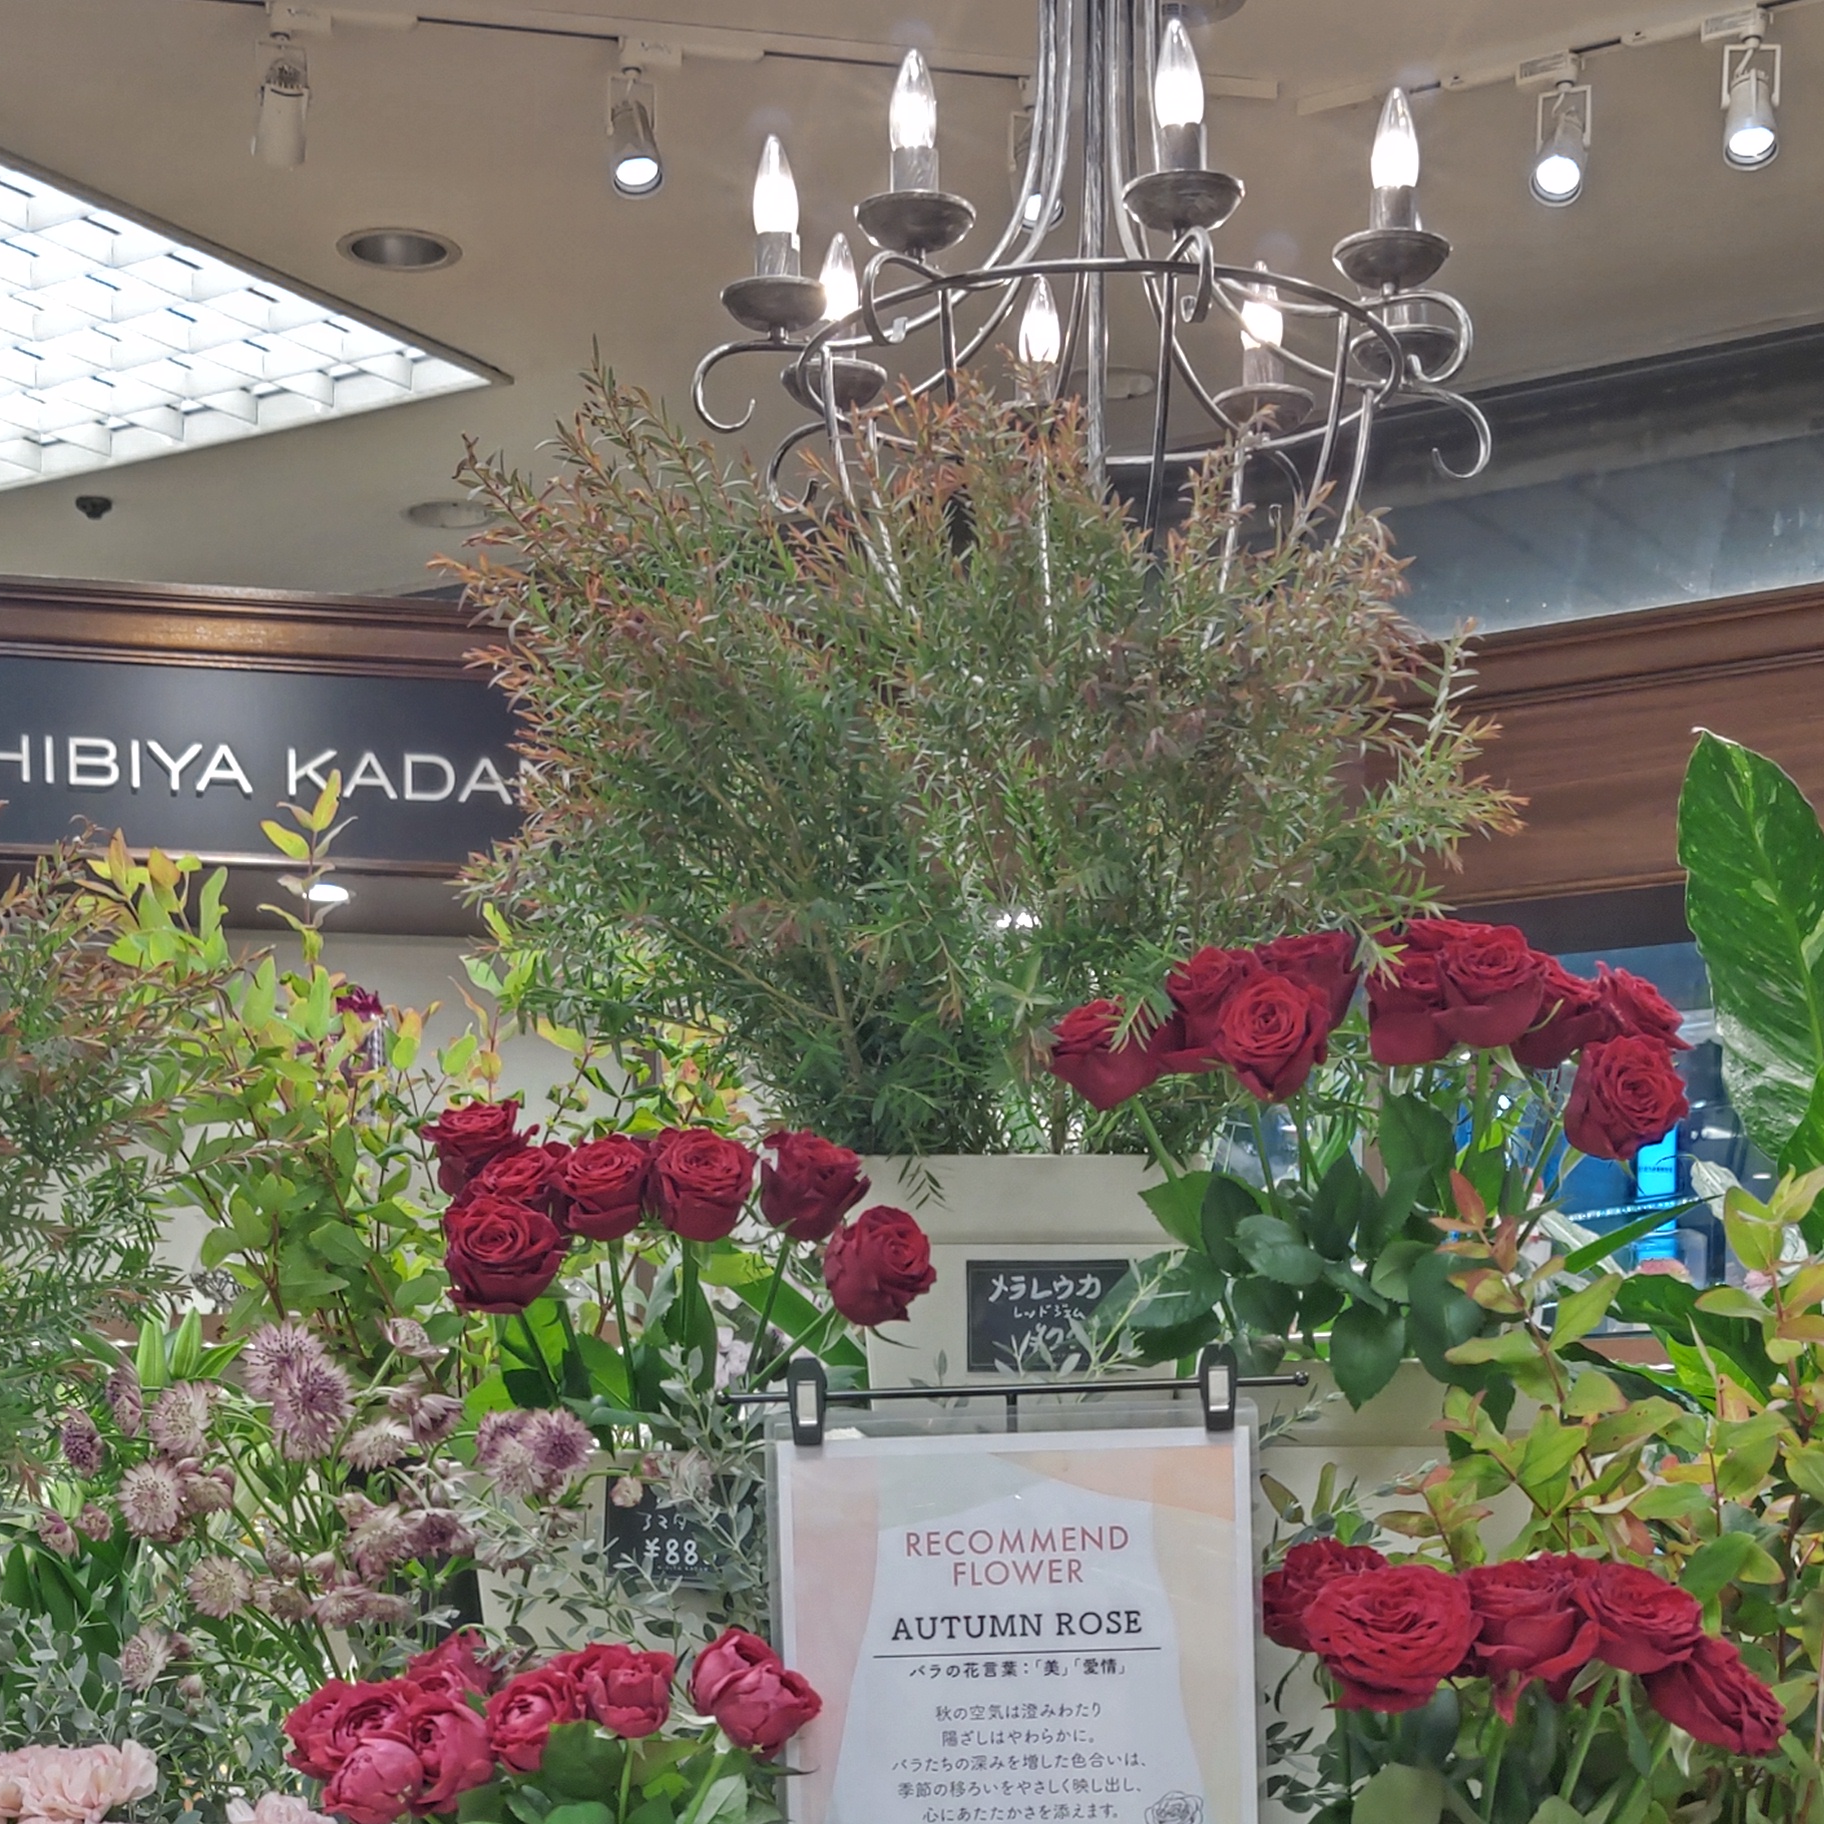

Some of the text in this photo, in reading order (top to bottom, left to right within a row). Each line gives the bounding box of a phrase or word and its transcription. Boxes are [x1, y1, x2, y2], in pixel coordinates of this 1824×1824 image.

[988, 1272, 1102, 1302] メラレウカ
[644, 1538, 717, 1565] ¥88
[905, 1525, 1130, 1558] RECOMMEND
[951, 1557, 1085, 1588] FLOWER
[891, 1610, 1143, 1641] AUTUMN ROSE
[935, 1701, 1102, 1722] 秋の空気は澄みわたり
[941, 1728, 1096, 1748] 陽ざしはやわらかに。
[891, 1751, 1147, 1773] バラたちの深みを増した色合いは、
[897, 1776, 1143, 1799] 季節の移ろいをやさしく映し出し、
[922, 1803, 1119, 1824] 心にあたたかさを添えます。
